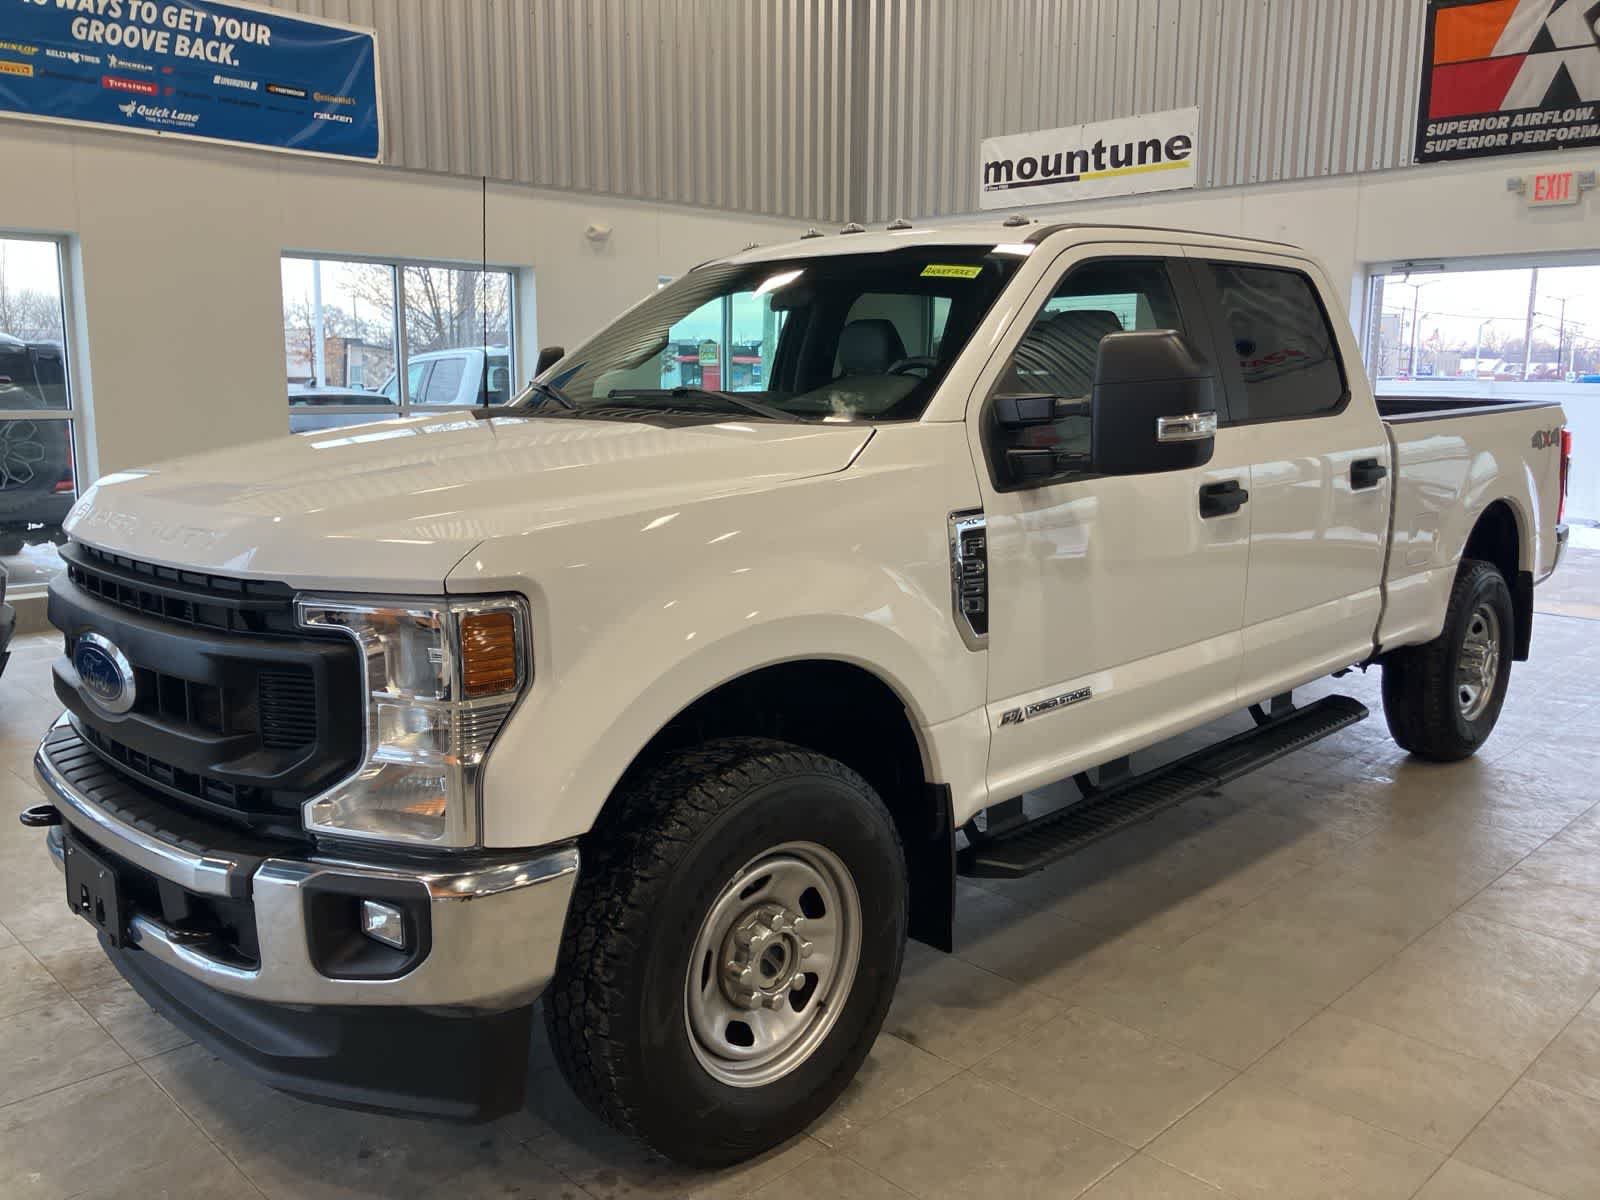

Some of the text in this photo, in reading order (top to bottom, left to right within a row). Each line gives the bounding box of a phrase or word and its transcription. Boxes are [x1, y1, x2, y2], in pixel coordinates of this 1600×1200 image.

[128, 1, 157, 24] TO
[163, 5, 206, 33] GET
[212, 14, 271, 46] YOUR
[71, 16, 239, 66] GROOVE BACK.
[137, 104, 200, 123] Quick Lane
[1425, 106, 1596, 137] SUPERIOR AIRFLOW.
[983, 134, 1192, 185] mountune
[1423, 134, 1508, 154] SUPERIOR
[1534, 172, 1573, 201] EXIT
